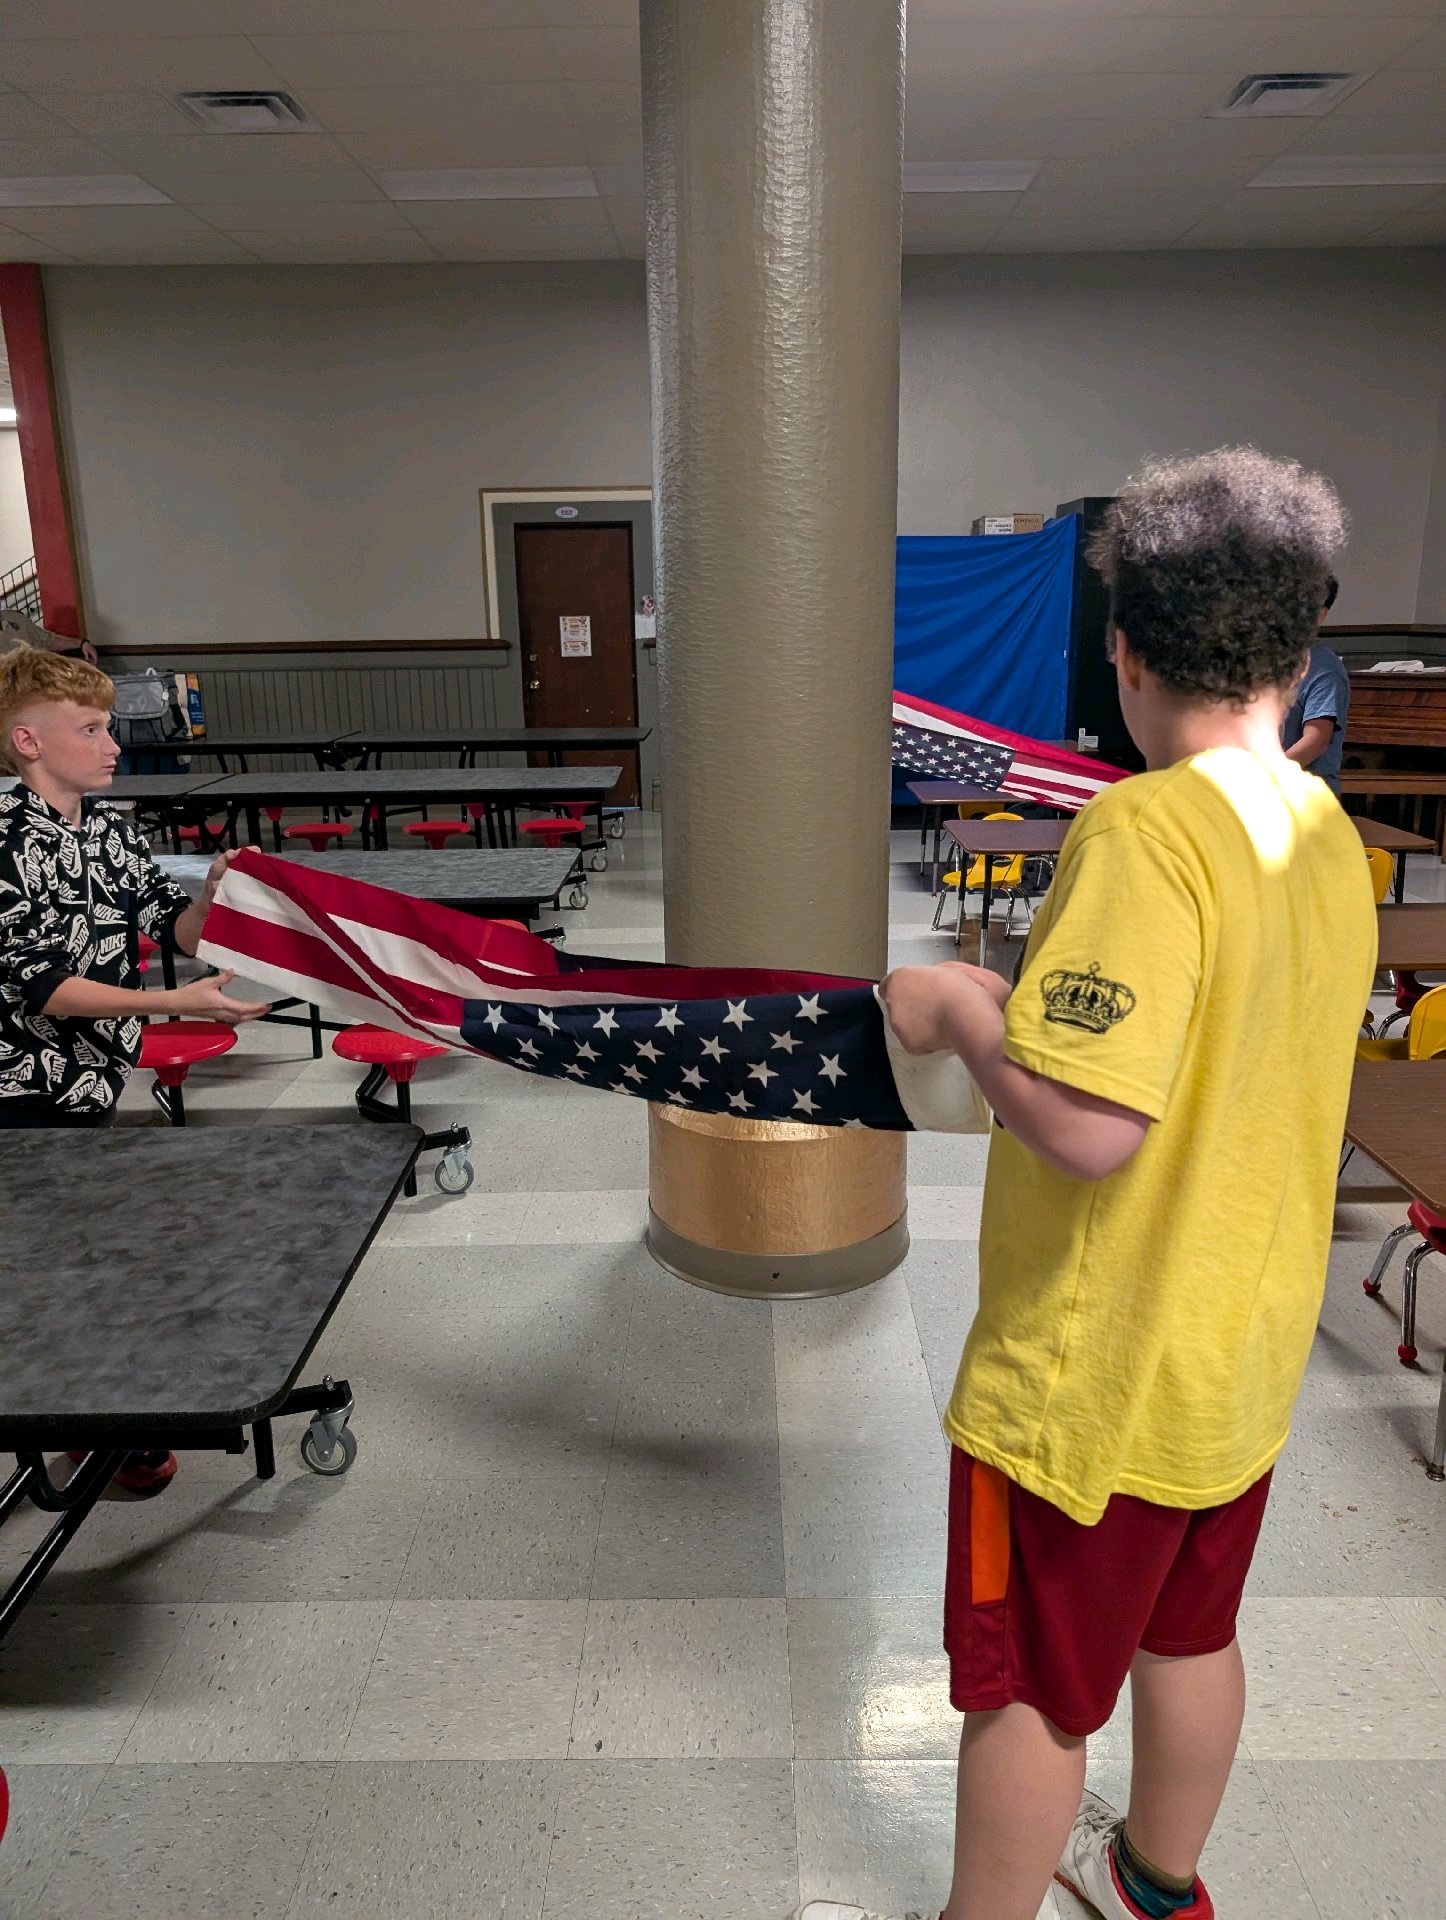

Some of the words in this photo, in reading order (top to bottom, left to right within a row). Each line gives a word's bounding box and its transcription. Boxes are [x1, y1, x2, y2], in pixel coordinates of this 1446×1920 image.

[105, 828, 121, 858] NIKE
[94, 903, 125, 921] NIKE
[72, 924, 90, 958] NIKE
[101, 932, 127, 954] NIKE
[78, 944, 95, 976] NIKE
[30, 1015, 59, 1038] NIKE
[119, 1016, 142, 1043] NIKE
[73, 1041, 97, 1065] NIKE
[50, 1054, 68, 1083] NIKE
[69, 1080, 95, 1105] NIKE
